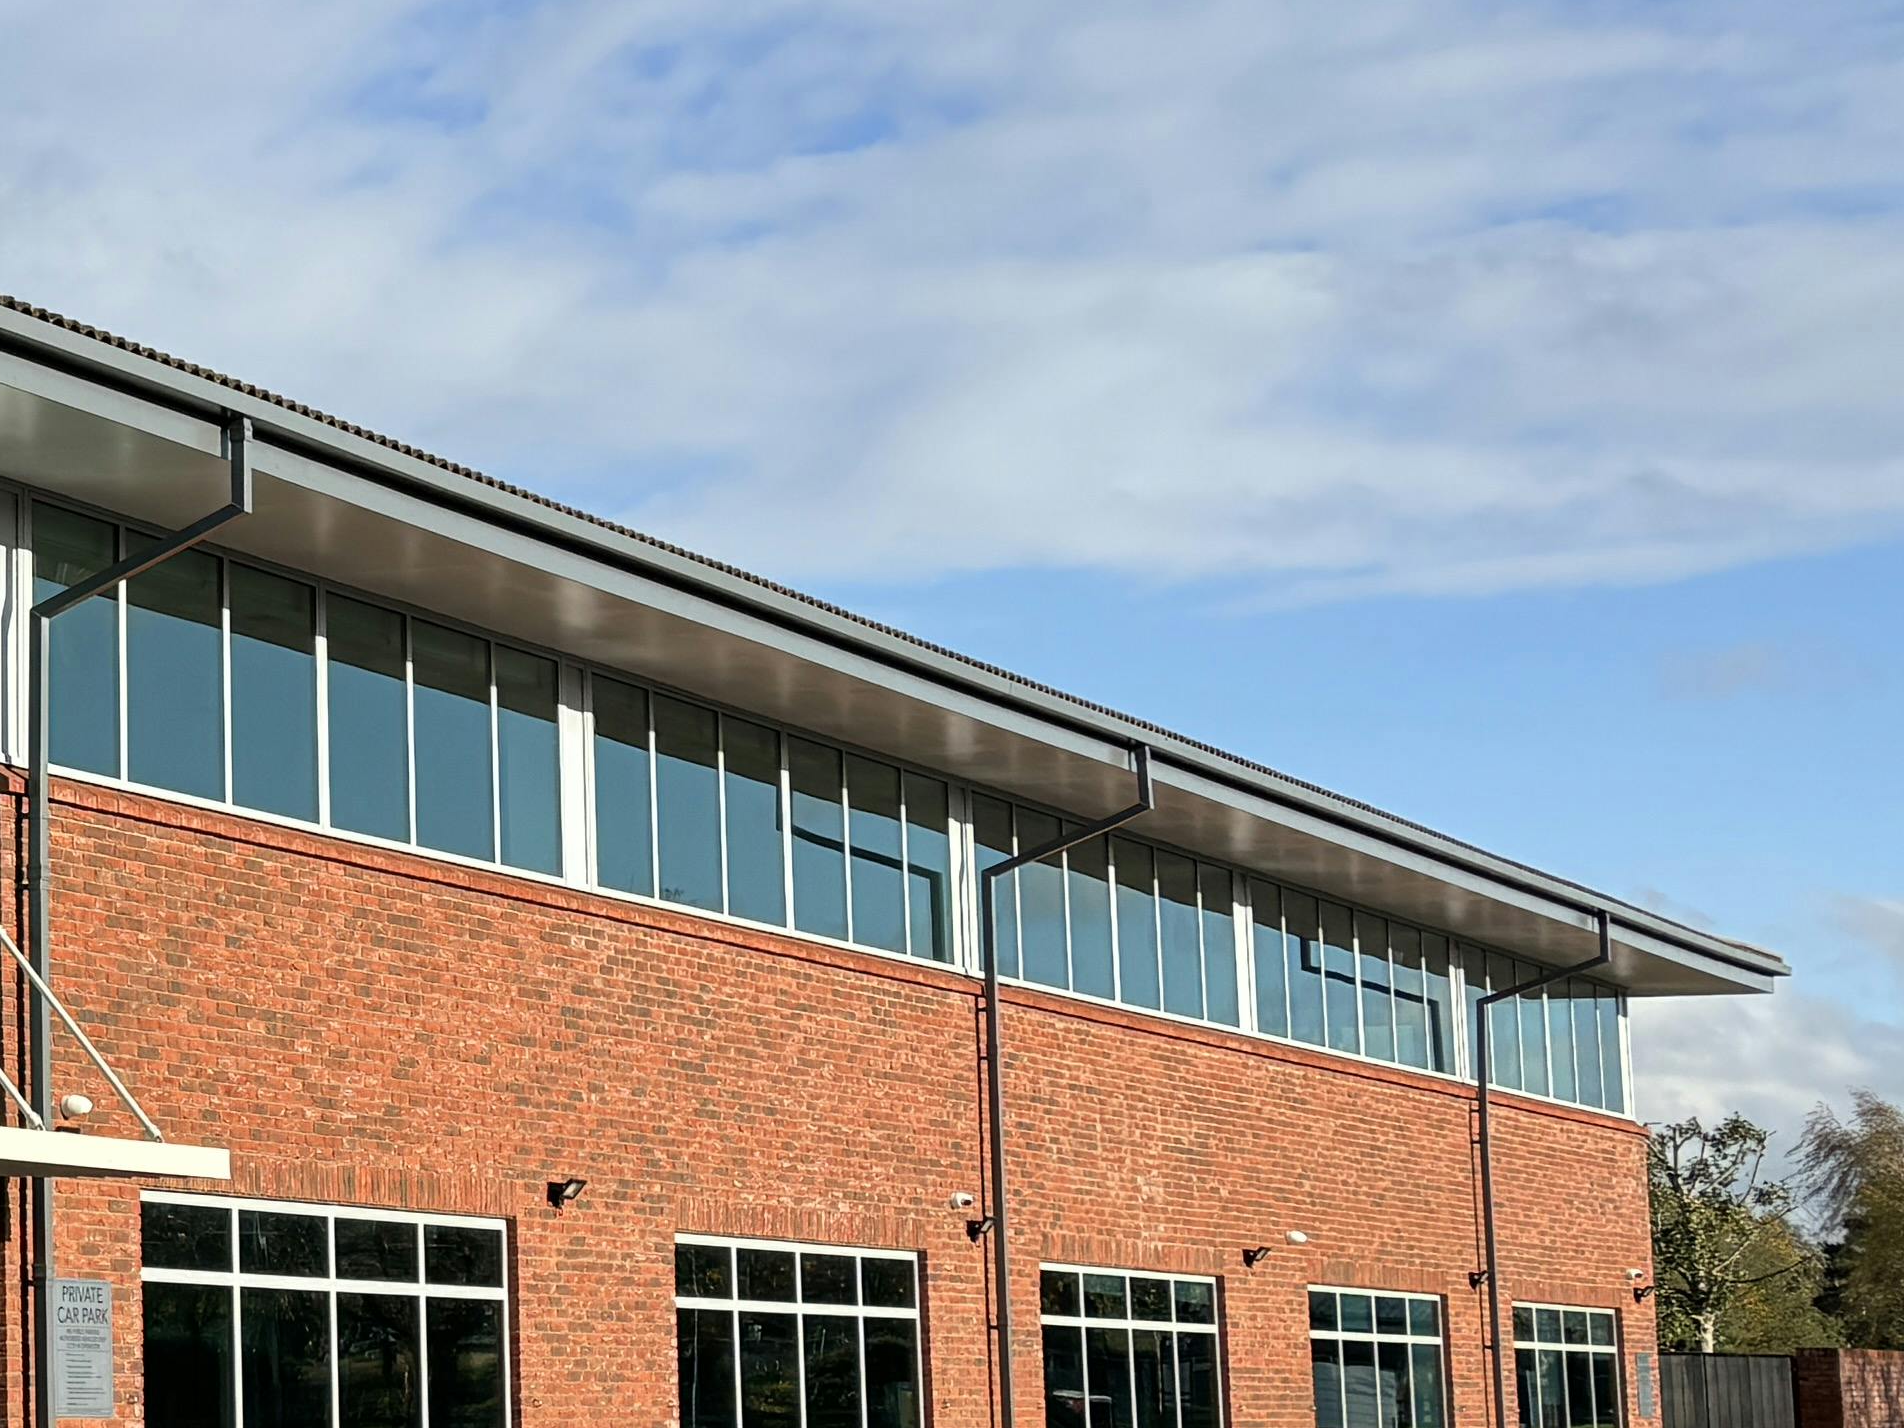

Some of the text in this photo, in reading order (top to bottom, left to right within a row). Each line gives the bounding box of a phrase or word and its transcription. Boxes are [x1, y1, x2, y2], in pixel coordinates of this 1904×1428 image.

[62, 1285, 103, 1303] PRIVATE
[57, 1306, 108, 1324] CAR PARK
